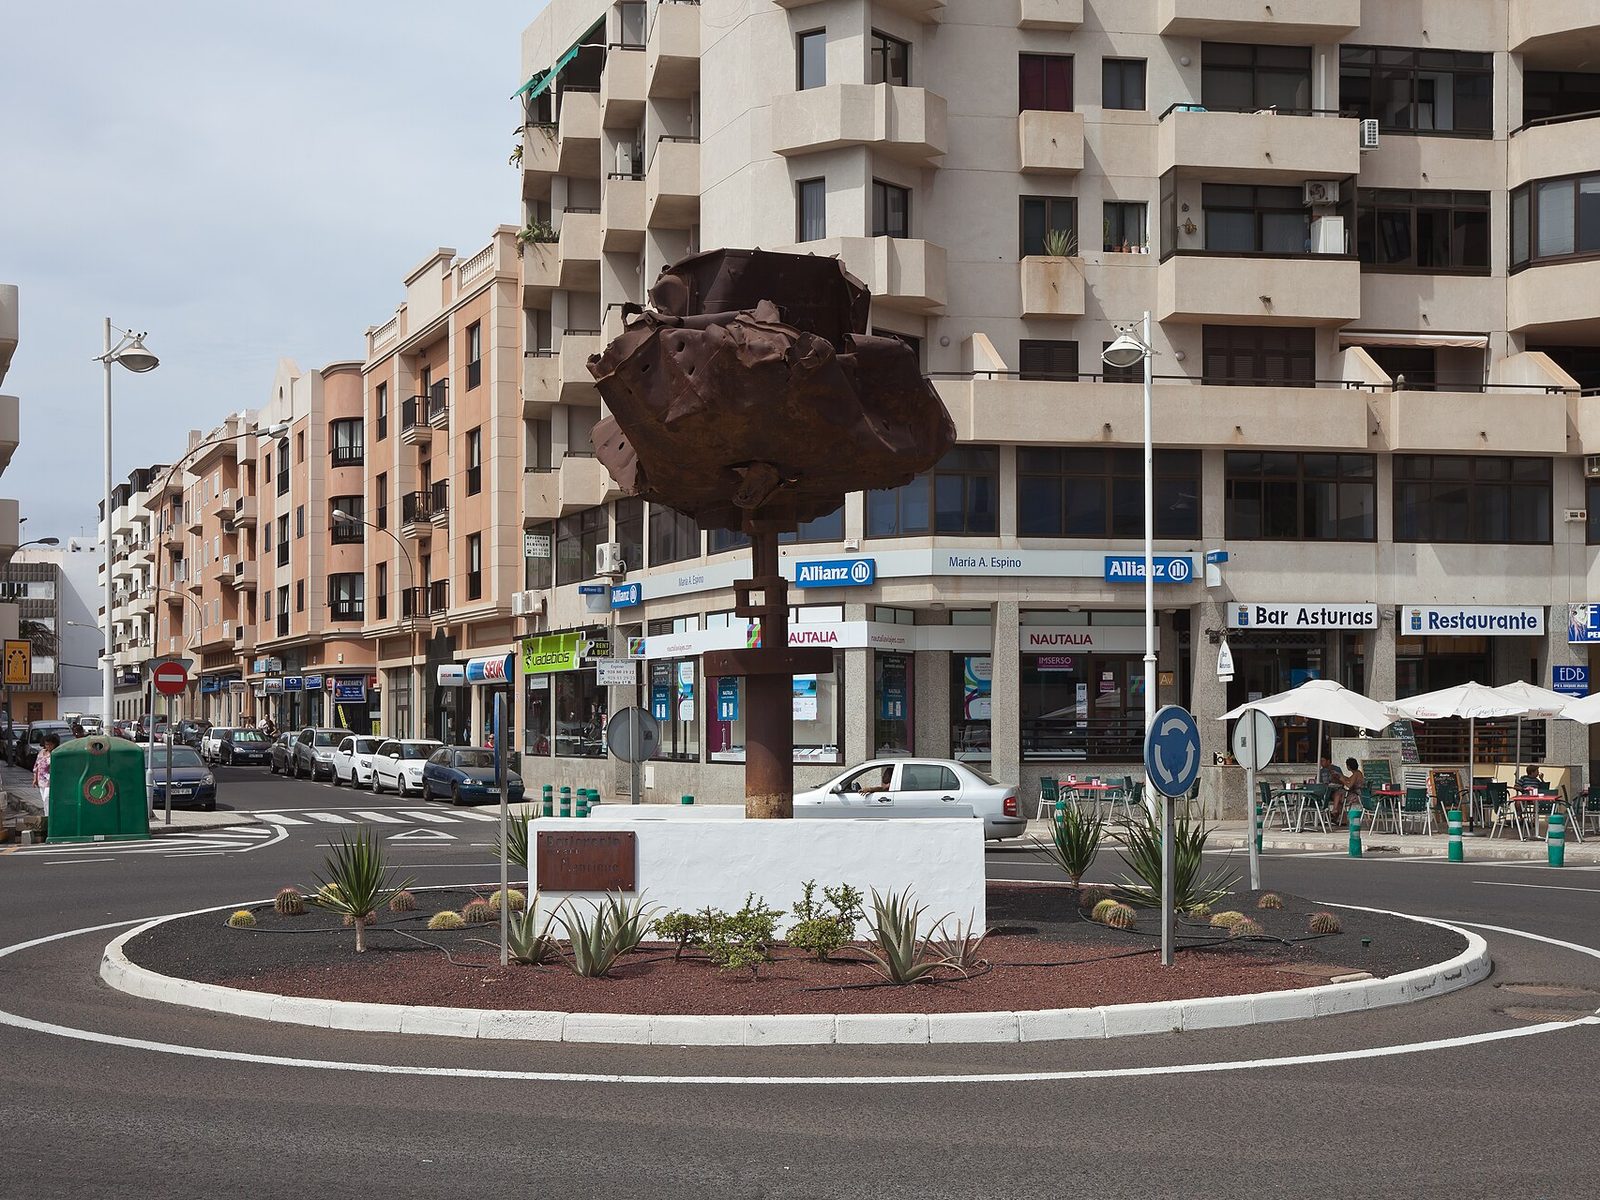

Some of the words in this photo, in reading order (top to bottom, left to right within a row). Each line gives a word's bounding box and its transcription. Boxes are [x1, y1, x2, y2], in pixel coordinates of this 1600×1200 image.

[949, 556, 976, 567] María
[978, 557, 988, 567] A.
[991, 556, 1022, 568] Espino
[799, 565, 849, 582] Allianz
[611, 589, 630, 603] Allianz
[1255, 605, 1289, 625] Bar
[1296, 607, 1373, 625] Asturias
[1428, 611, 1538, 630] Restaurante
[788, 631, 838, 643] AUTALIA
[1030, 634, 1093, 645] NAUTALIA
[1038, 656, 1072, 665] IMSERSO
[484, 660, 505, 679] SEUR
[1559, 667, 1585, 681] EDB
